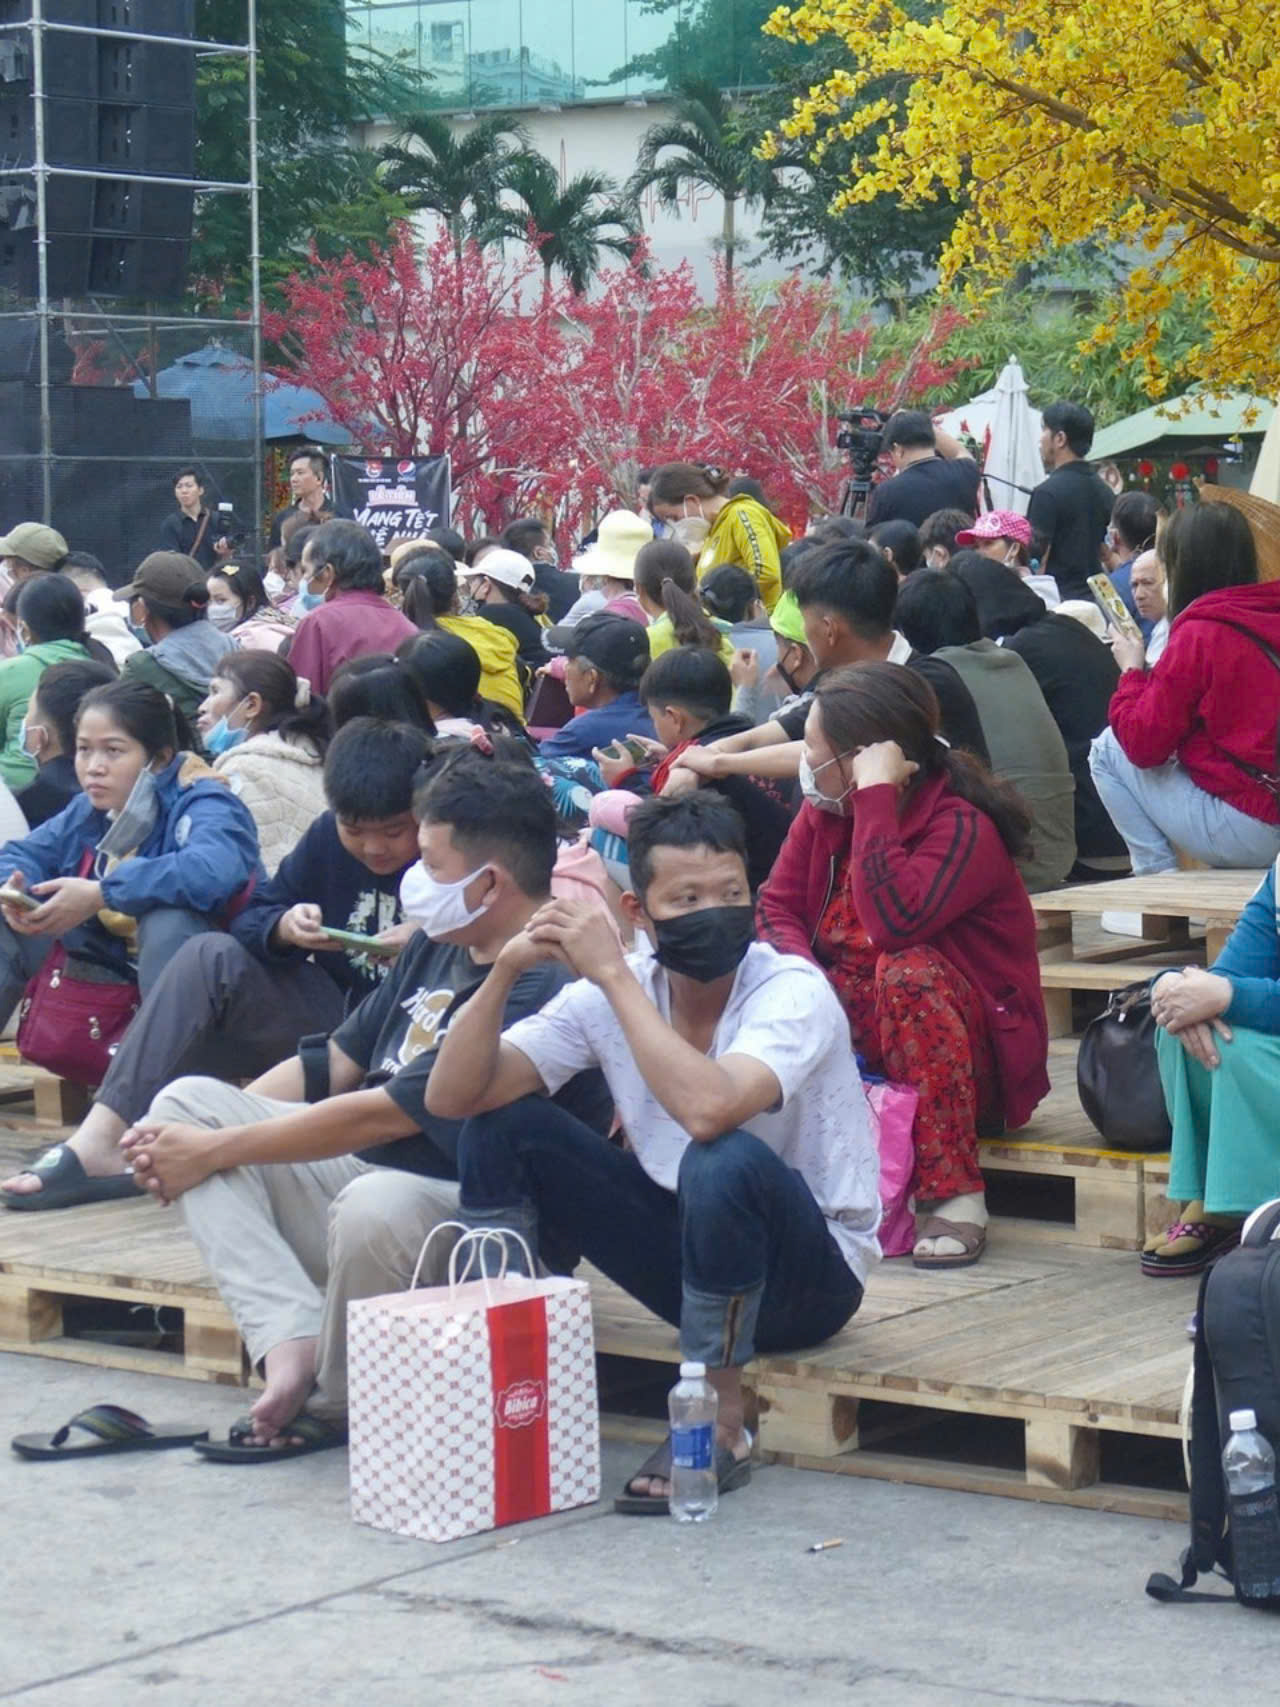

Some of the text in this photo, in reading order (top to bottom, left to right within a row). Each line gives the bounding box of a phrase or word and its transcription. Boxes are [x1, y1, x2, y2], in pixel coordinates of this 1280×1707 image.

[353, 508, 439, 529] MANG TẾT
[504, 1396, 538, 1417] Bibica
